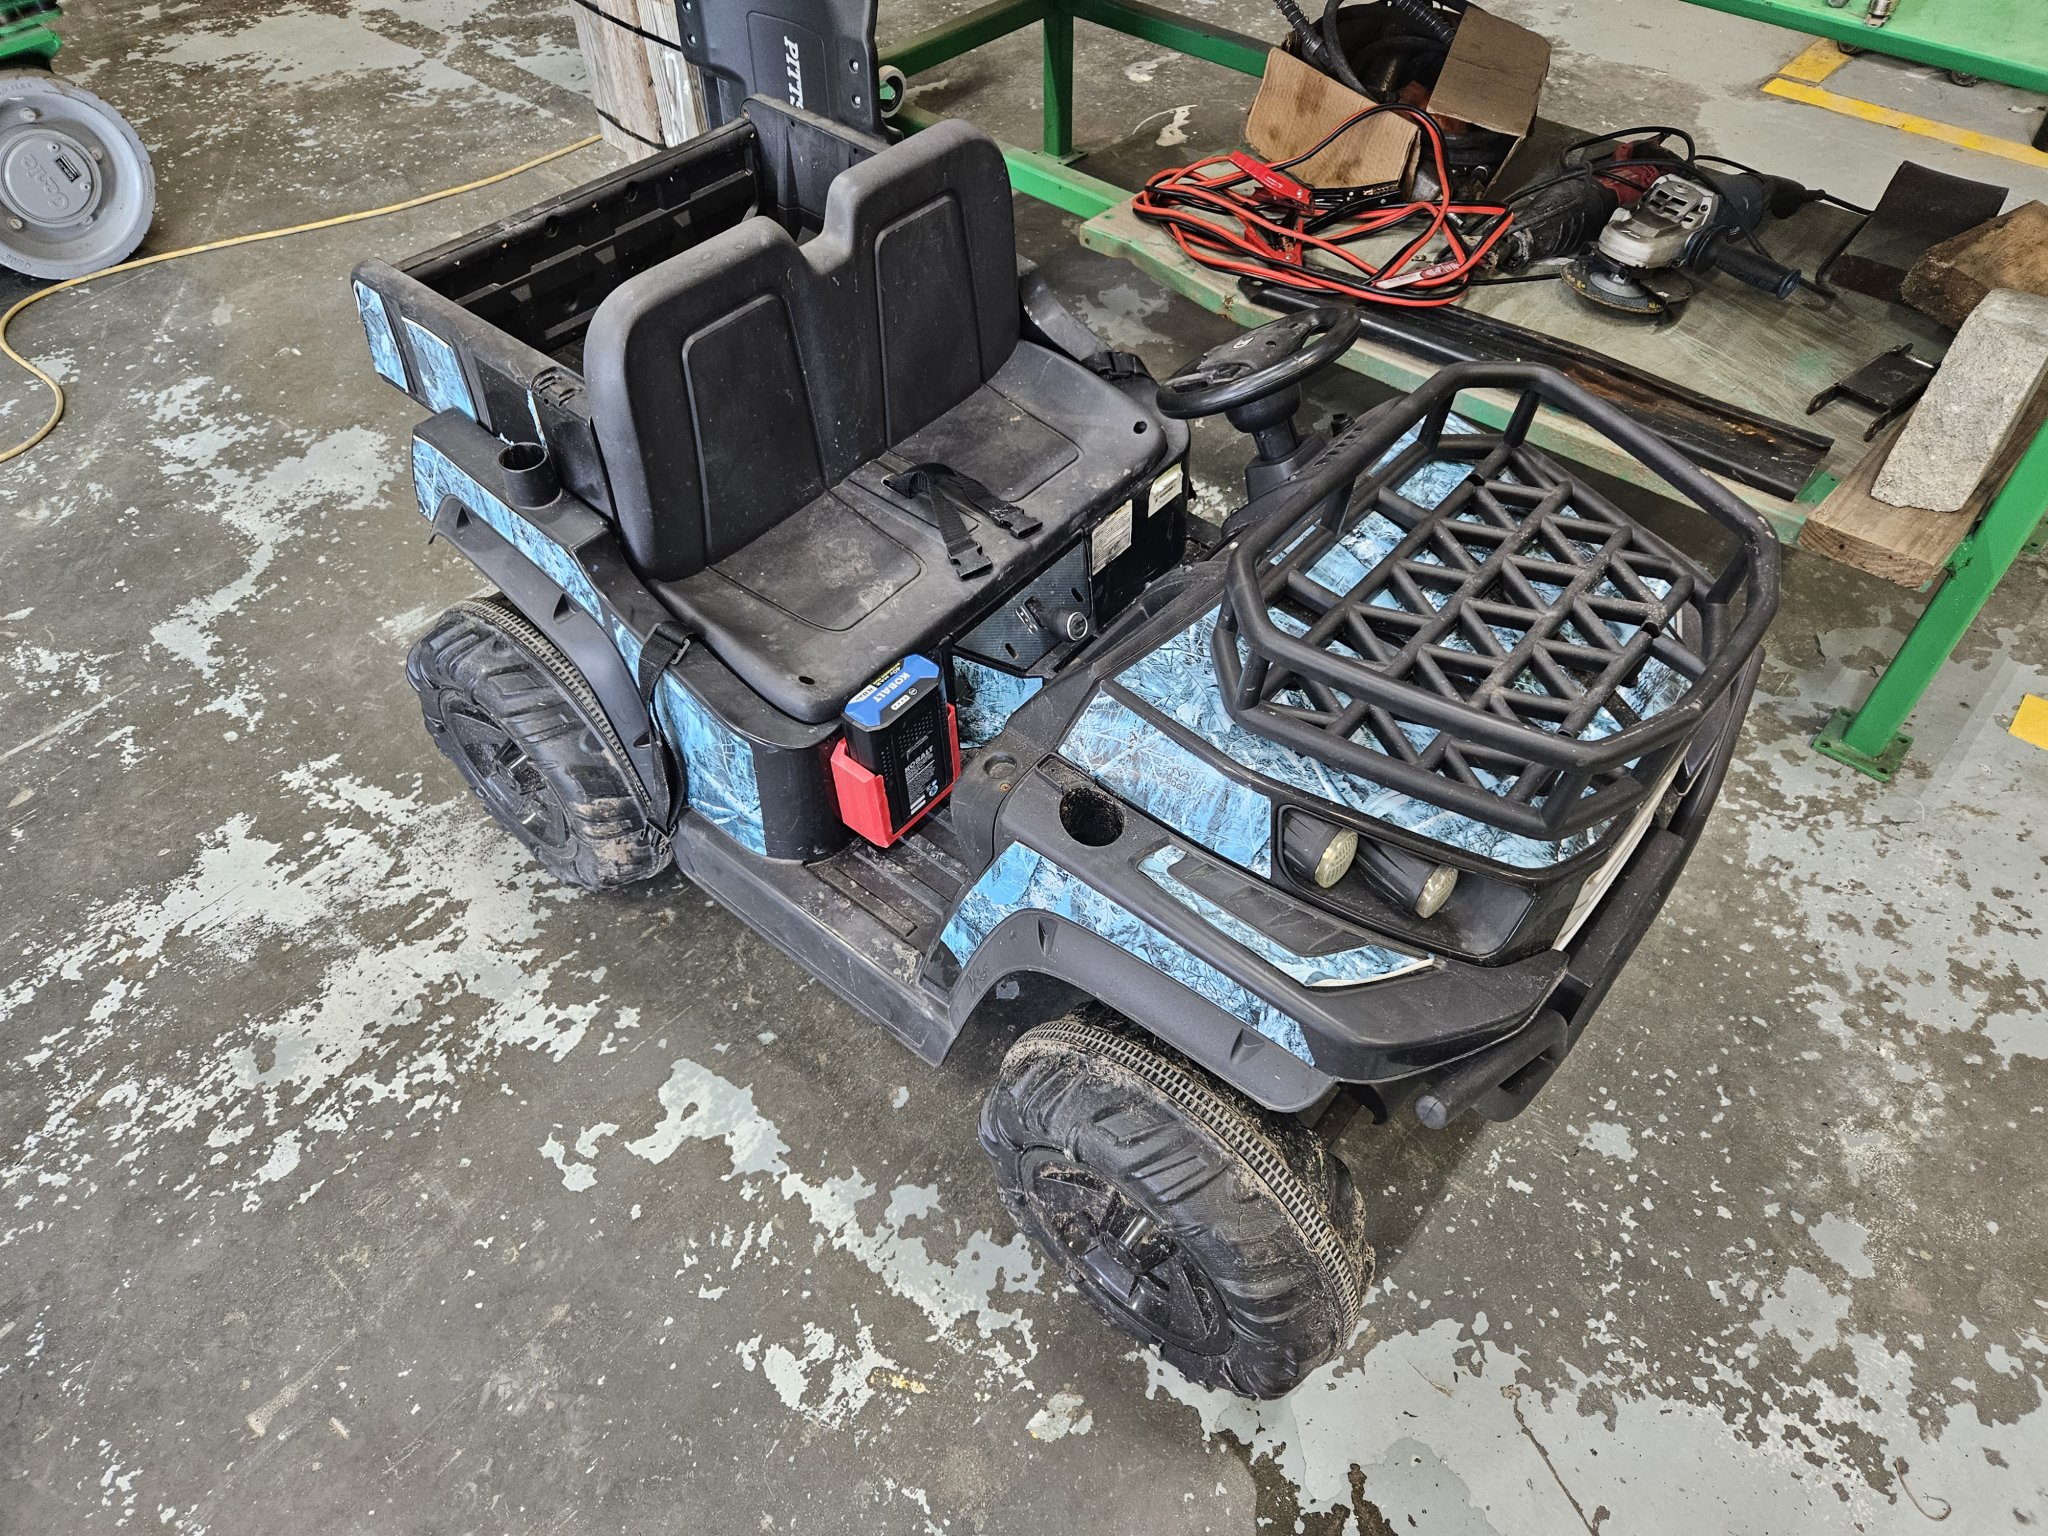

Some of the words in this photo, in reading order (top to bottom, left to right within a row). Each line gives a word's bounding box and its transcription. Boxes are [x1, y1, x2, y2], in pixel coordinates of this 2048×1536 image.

[873, 672, 911, 703] KOBALT
[904, 745, 934, 772] KOBALT
[1166, 776, 1188, 793] EDGE
